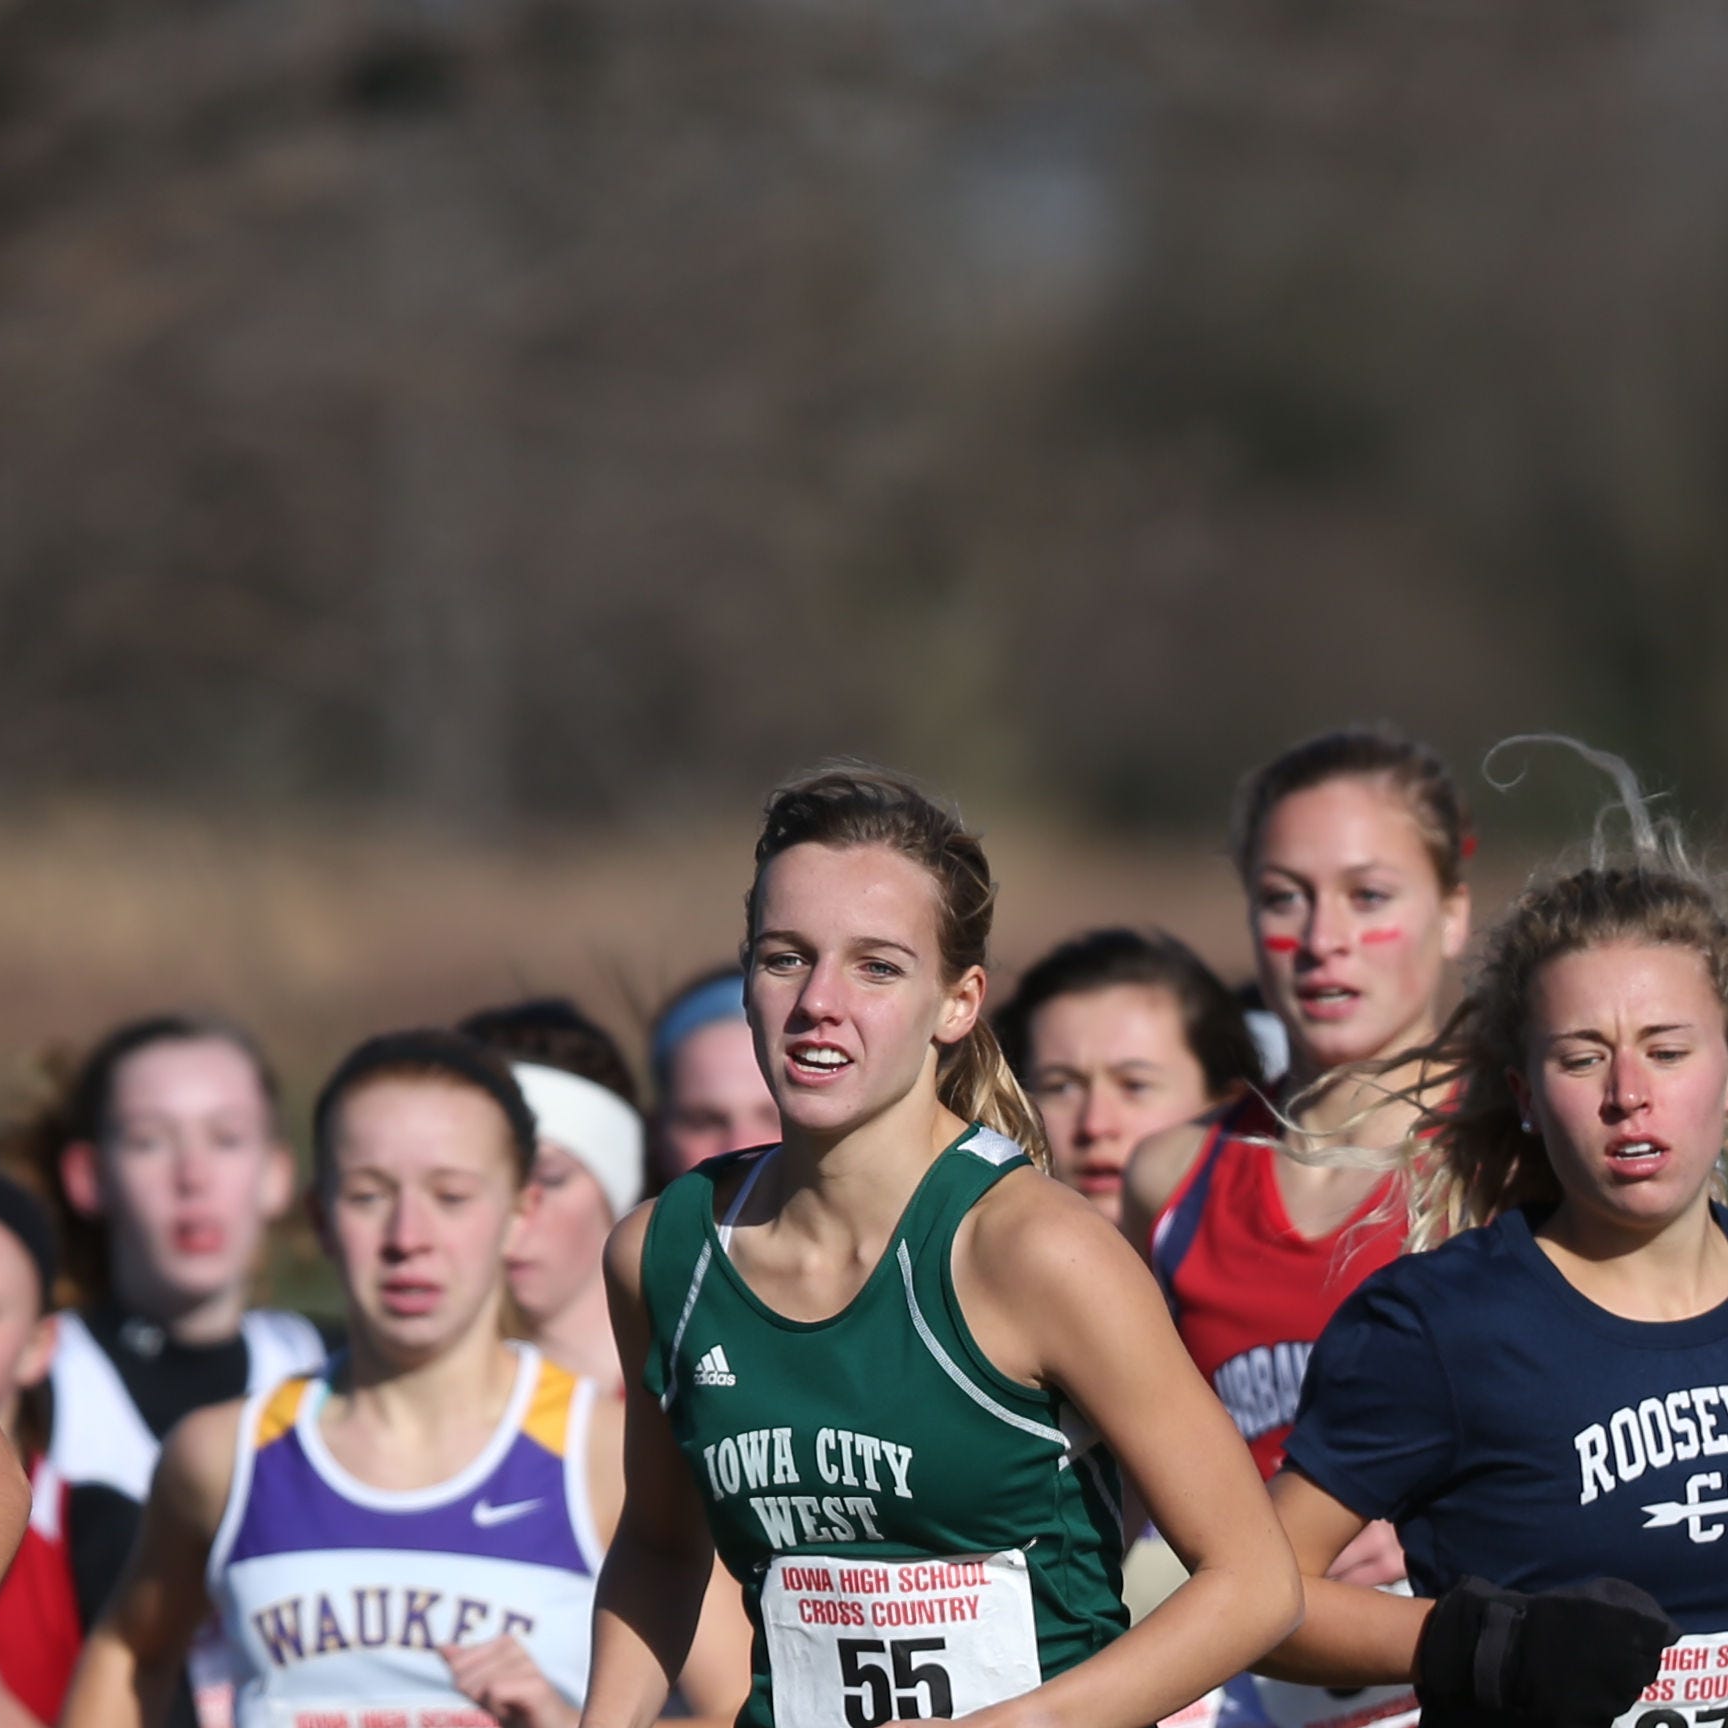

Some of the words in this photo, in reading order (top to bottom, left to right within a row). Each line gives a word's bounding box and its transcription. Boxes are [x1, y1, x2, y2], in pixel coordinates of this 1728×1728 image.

[704, 1427, 800, 1501] IOWA
[816, 1427, 914, 1499] CITY
[749, 1496, 885, 1550] WEST
[781, 1566, 833, 1593] IOWA
[839, 1565, 890, 1594] HIGH
[897, 1560, 992, 1593] SCHOOL
[798, 1600, 866, 1627] CROSS
[871, 1595, 980, 1627] COUNTRY
[1660, 1647, 1708, 1671] HIGH
